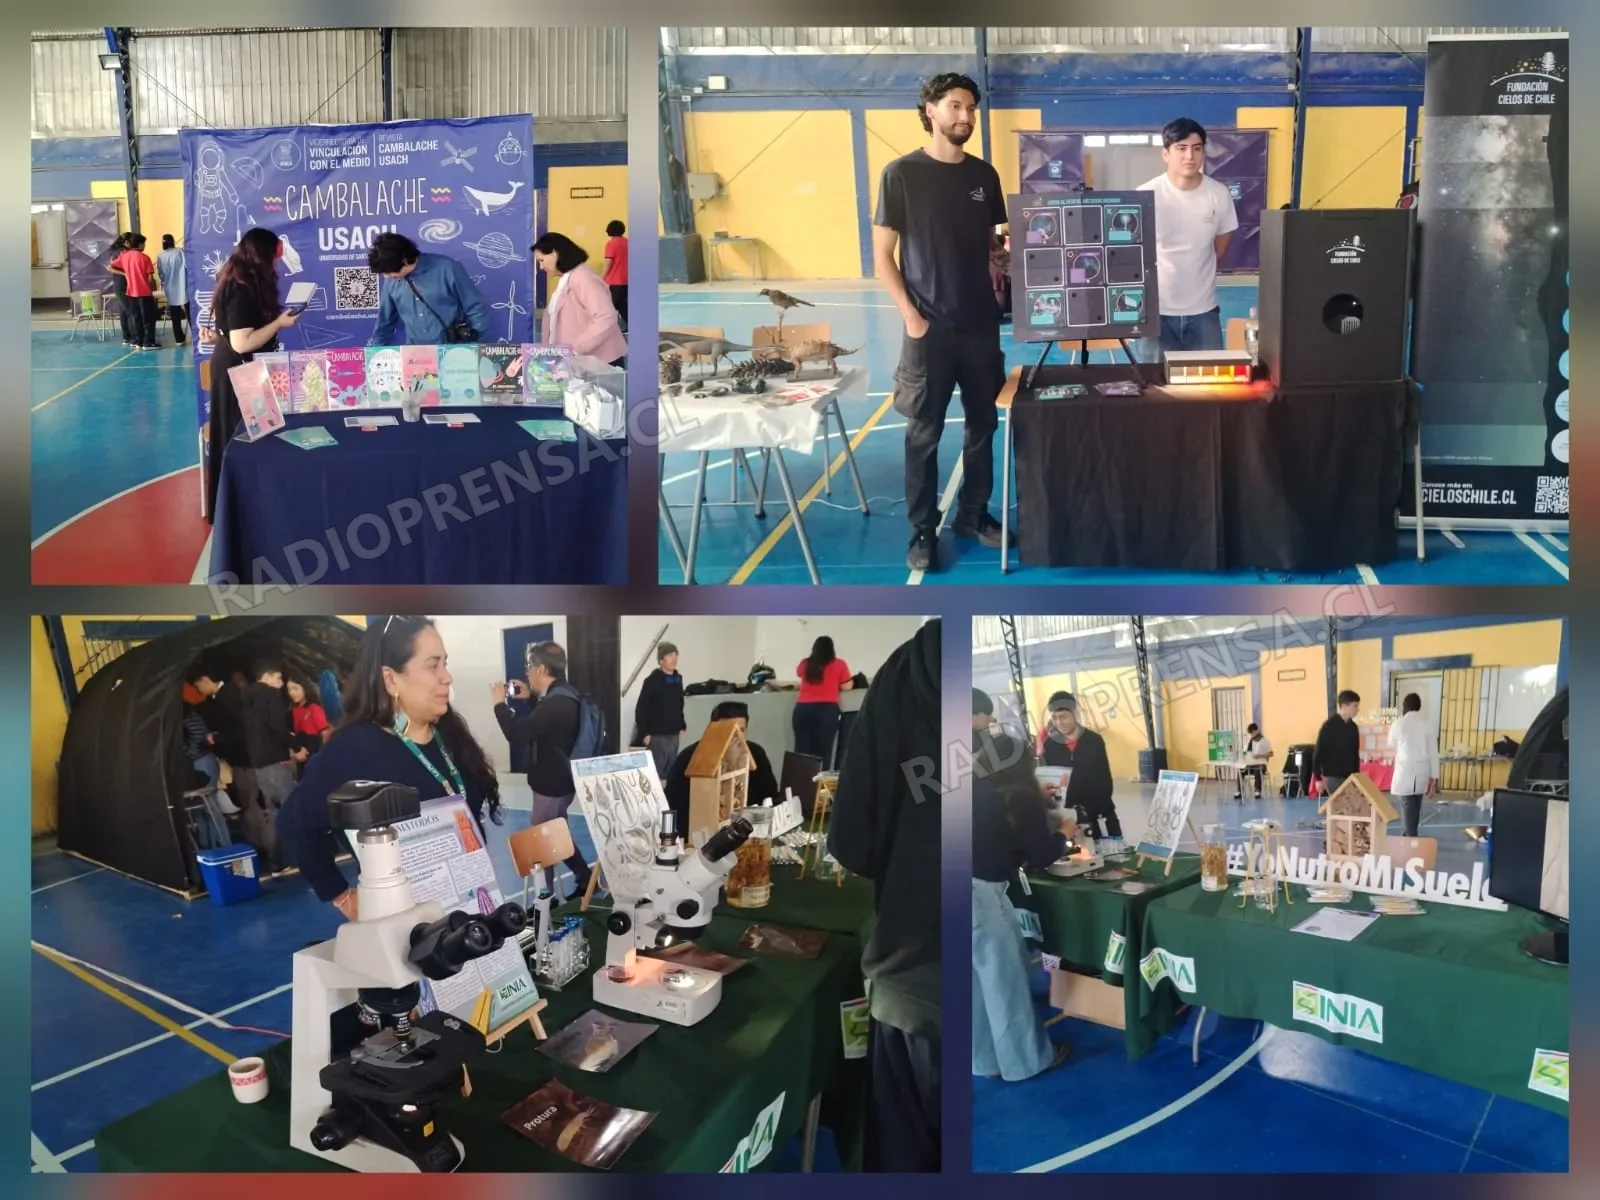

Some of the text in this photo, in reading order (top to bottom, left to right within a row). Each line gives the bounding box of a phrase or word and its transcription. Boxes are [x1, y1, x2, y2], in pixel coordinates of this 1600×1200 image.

[1507, 80, 1549, 92] FUNDACIÓN
[1498, 94, 1556, 105] CIELOS DE CHILE
[309, 145, 368, 158] VINCULACIÓN
[378, 140, 438, 153] CAMBALACHE
[310, 157, 371, 170] CON EL MEDIO
[379, 155, 409, 166] USACH
[285, 177, 428, 221] CAMBALACHE
[1421, 488, 1517, 505] CIELOSCHILE.CL
[507, 978, 527, 997] INIA
[1320, 994, 1380, 1034] INIA
[523, 1105, 558, 1131] Protura
